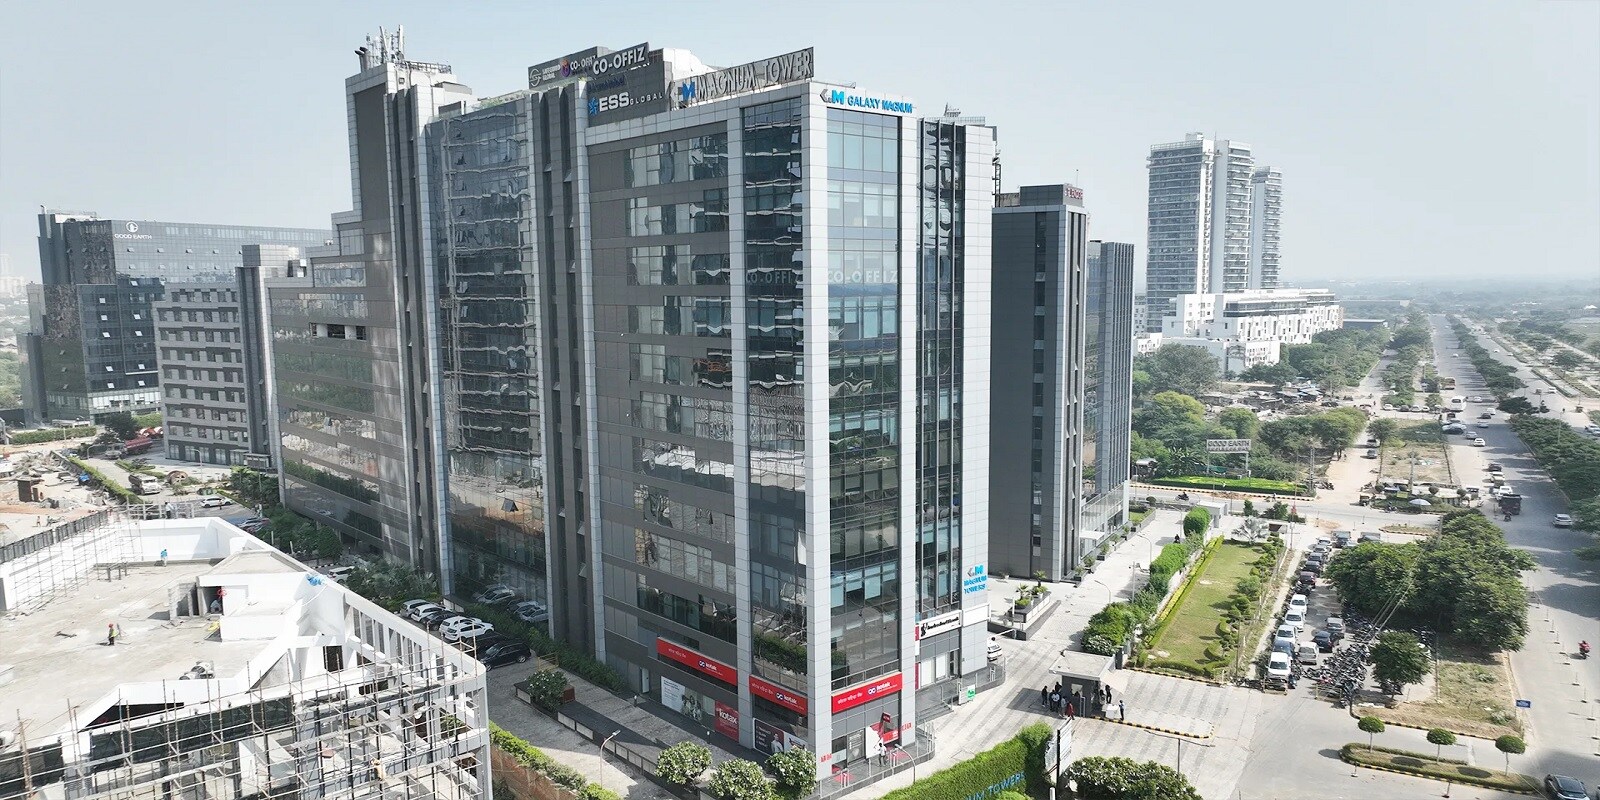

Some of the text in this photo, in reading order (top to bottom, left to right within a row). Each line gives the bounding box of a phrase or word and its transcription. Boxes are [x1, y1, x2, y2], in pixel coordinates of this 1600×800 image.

[592, 46, 645, 75] CO-OFFIZ
[699, 63, 756, 100] MAGNUM
[762, 49, 812, 86] TOWER
[599, 92, 663, 112] ESS GLOBAL
[847, 95, 880, 110] GALAXY
[881, 99, 913, 114] MAGNUM
[963, 575, 987, 587] MAGNUM
[963, 583, 986, 595] TOWERS
